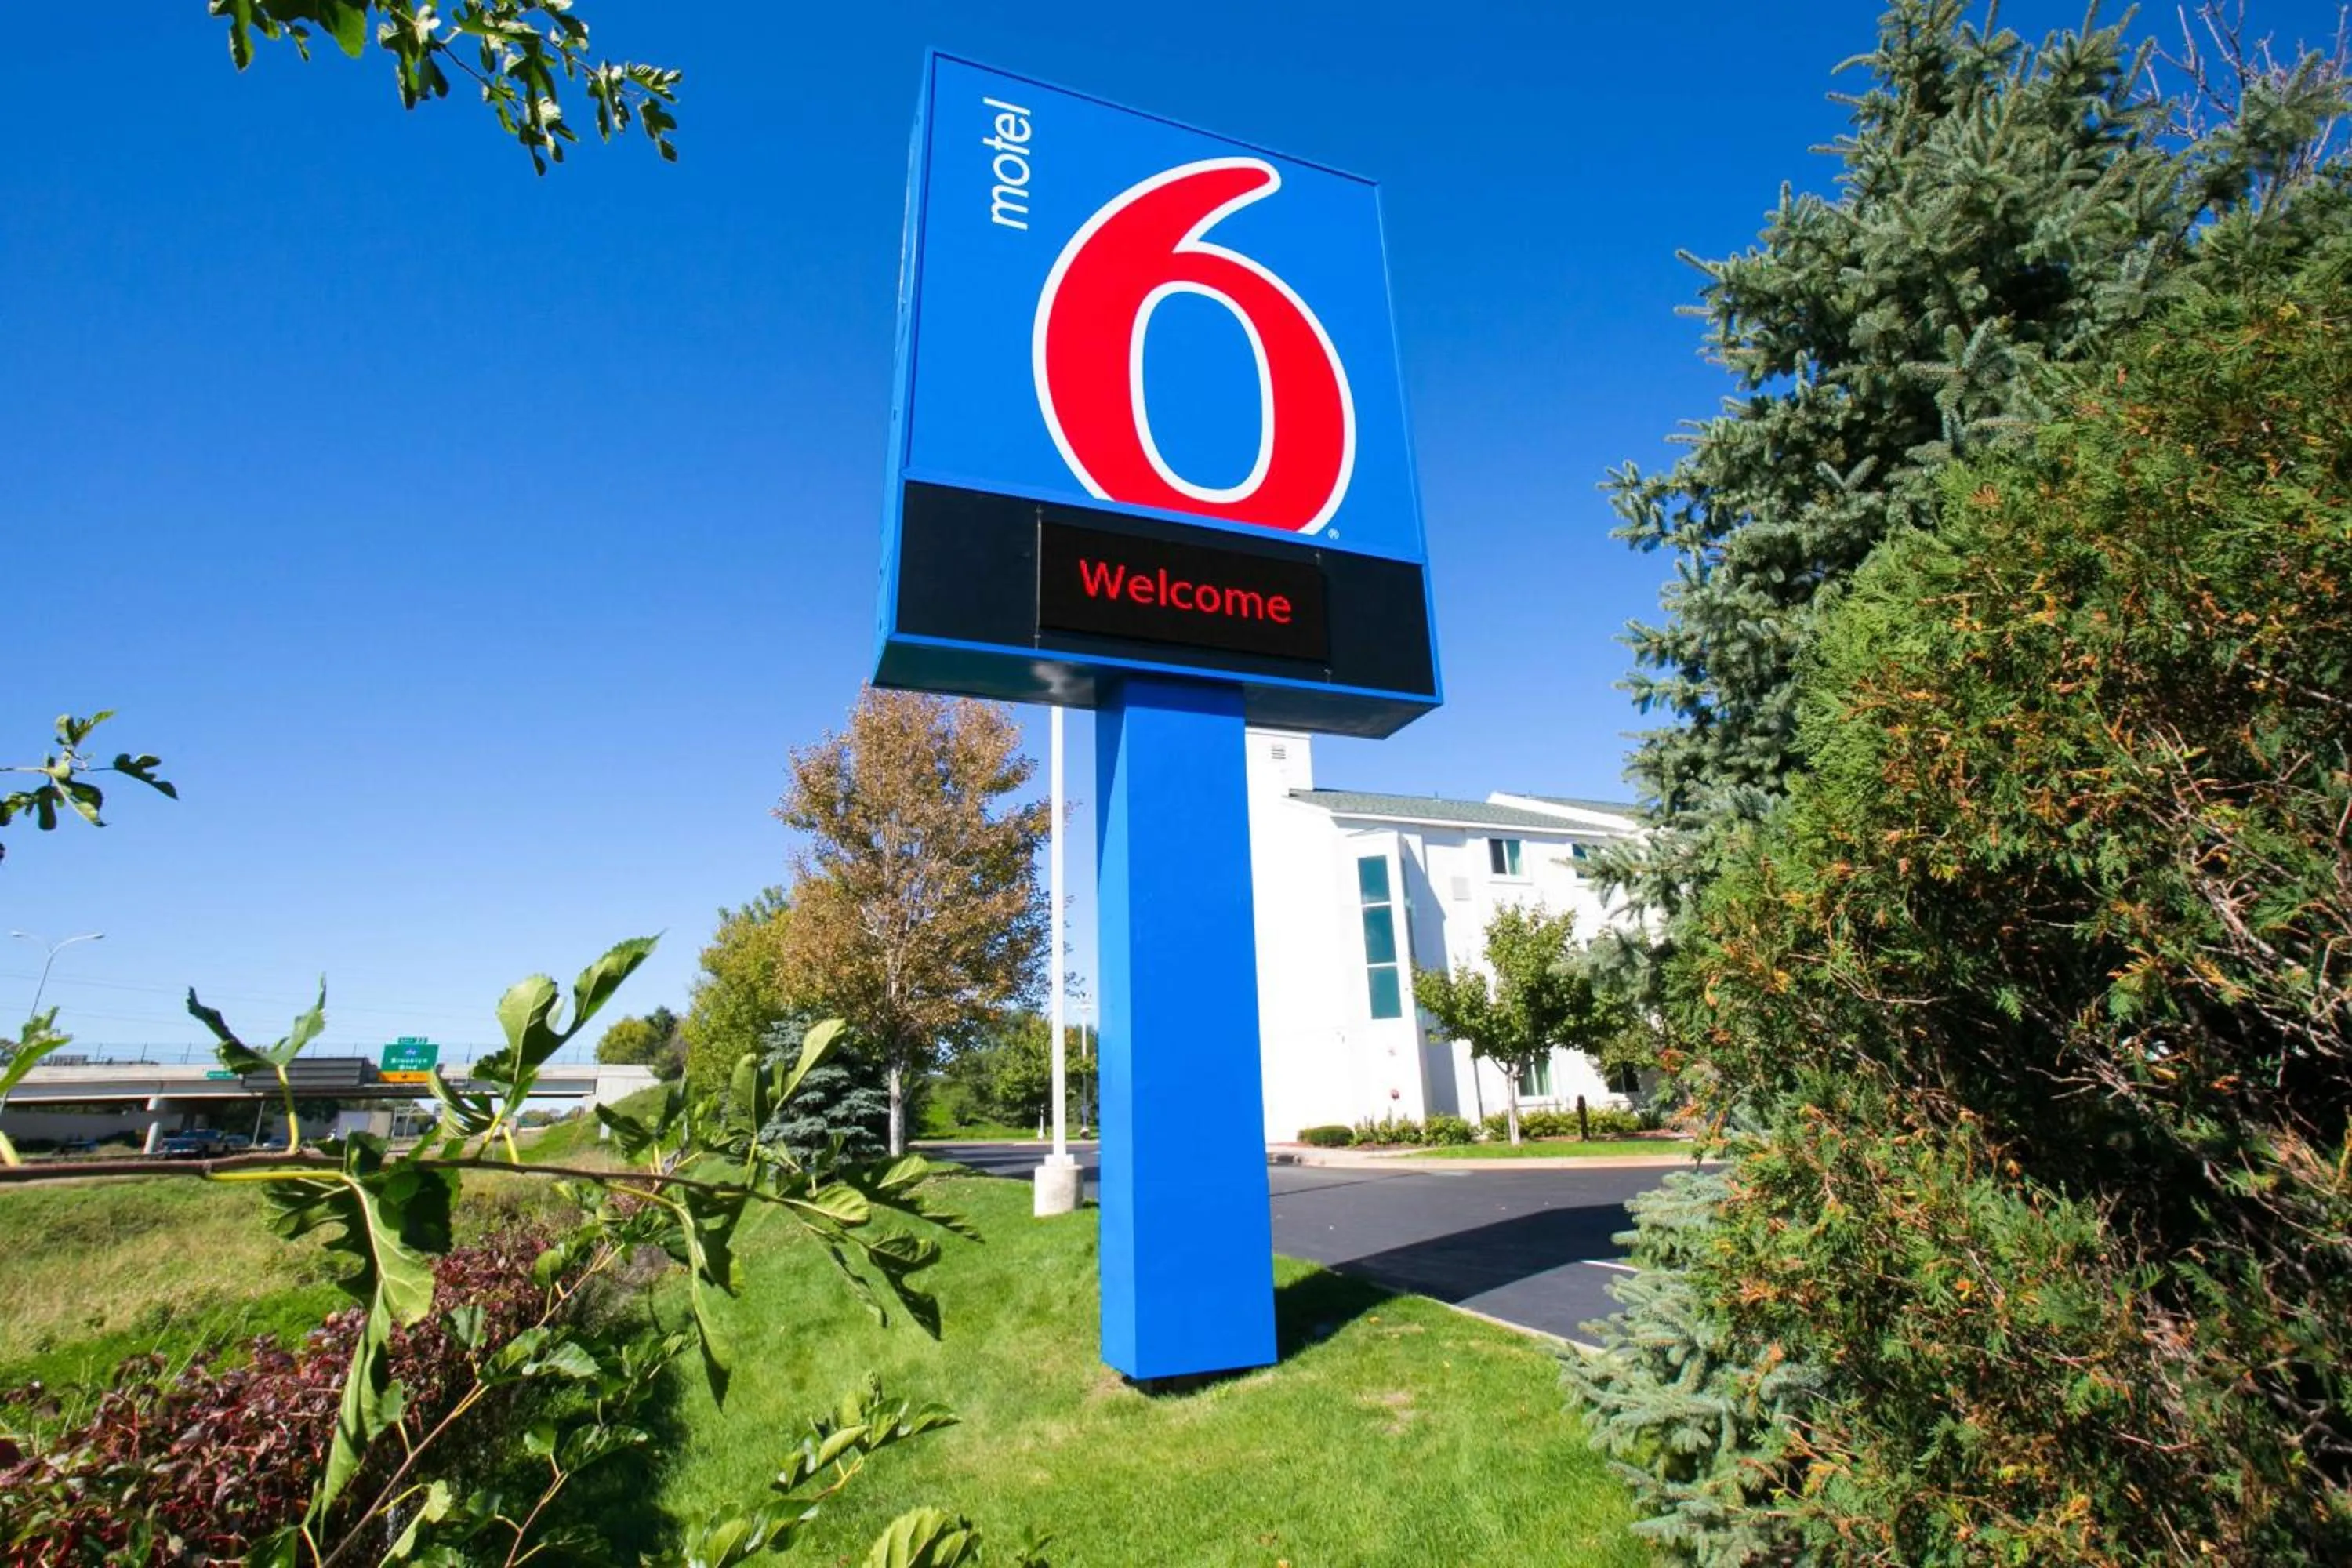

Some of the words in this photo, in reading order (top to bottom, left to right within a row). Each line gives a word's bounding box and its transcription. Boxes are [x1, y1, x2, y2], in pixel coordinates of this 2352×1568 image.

[983, 98, 1032, 230] motel
[1032, 157, 1356, 535] 6
[1079, 558, 1292, 623] Welcome
